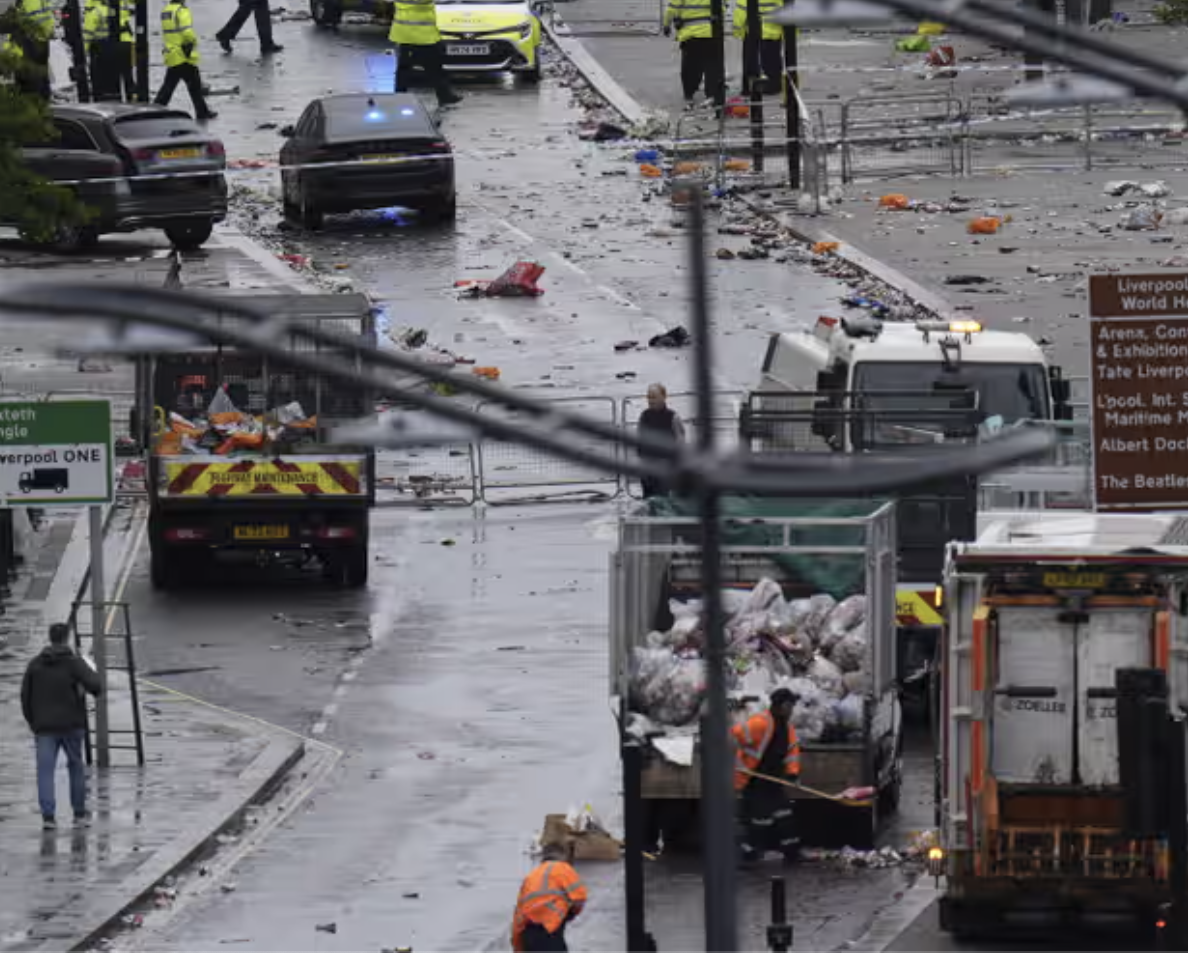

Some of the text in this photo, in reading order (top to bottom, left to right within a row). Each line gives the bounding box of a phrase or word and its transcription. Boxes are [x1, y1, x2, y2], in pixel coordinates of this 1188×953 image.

[1117, 277, 1188, 294] Liverpool
[1121, 296, 1167, 311] World
[1095, 345, 1107, 358] &
[1113, 342, 1188, 359] Exhibition
[1097, 364, 1132, 380] Tate
[1151, 393, 1176, 408] Int.
[1105, 411, 1172, 427] Maritime
[1100, 437, 1150, 453] Albert
[62, 448, 101, 464] ONE
[1100, 474, 1128, 489] The
